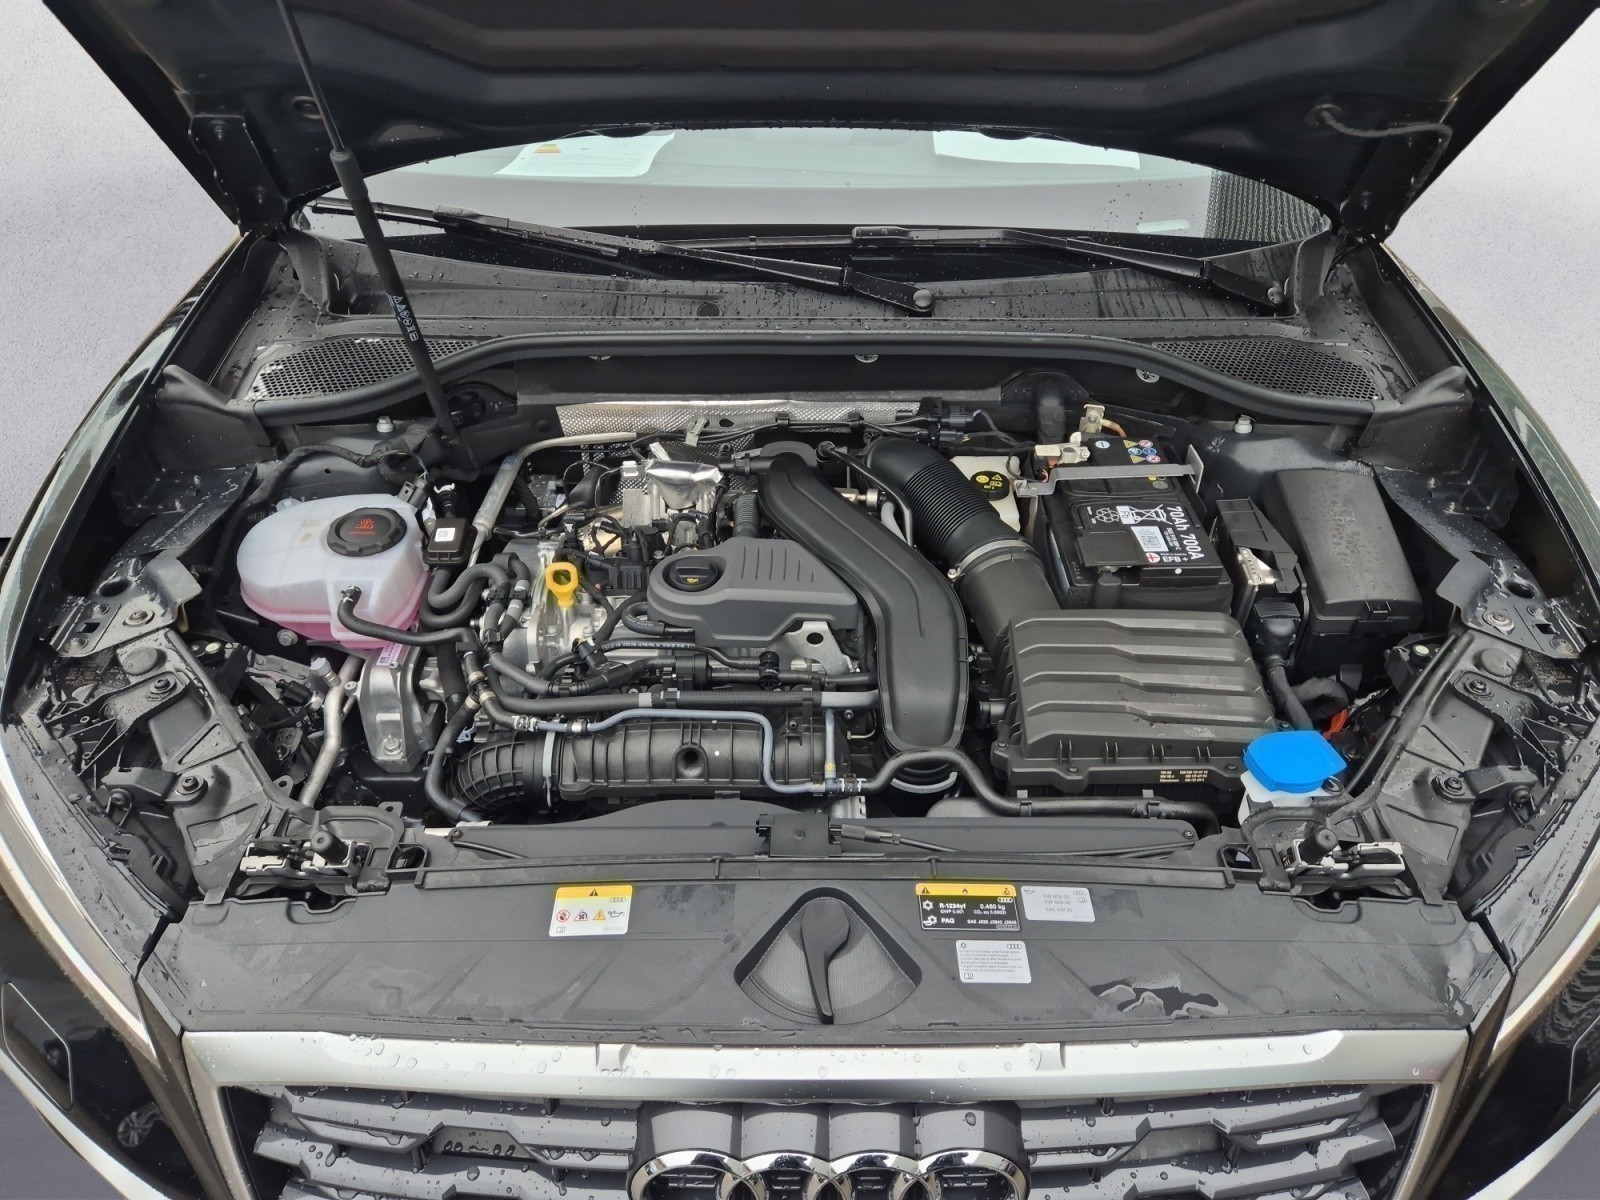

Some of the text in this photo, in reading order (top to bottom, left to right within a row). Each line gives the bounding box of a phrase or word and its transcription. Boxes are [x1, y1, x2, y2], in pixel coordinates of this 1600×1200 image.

[1167, 506, 1190, 531] 70Ah
[1180, 534, 1205, 560] 700A
[939, 902, 966, 910] R-1234yf
